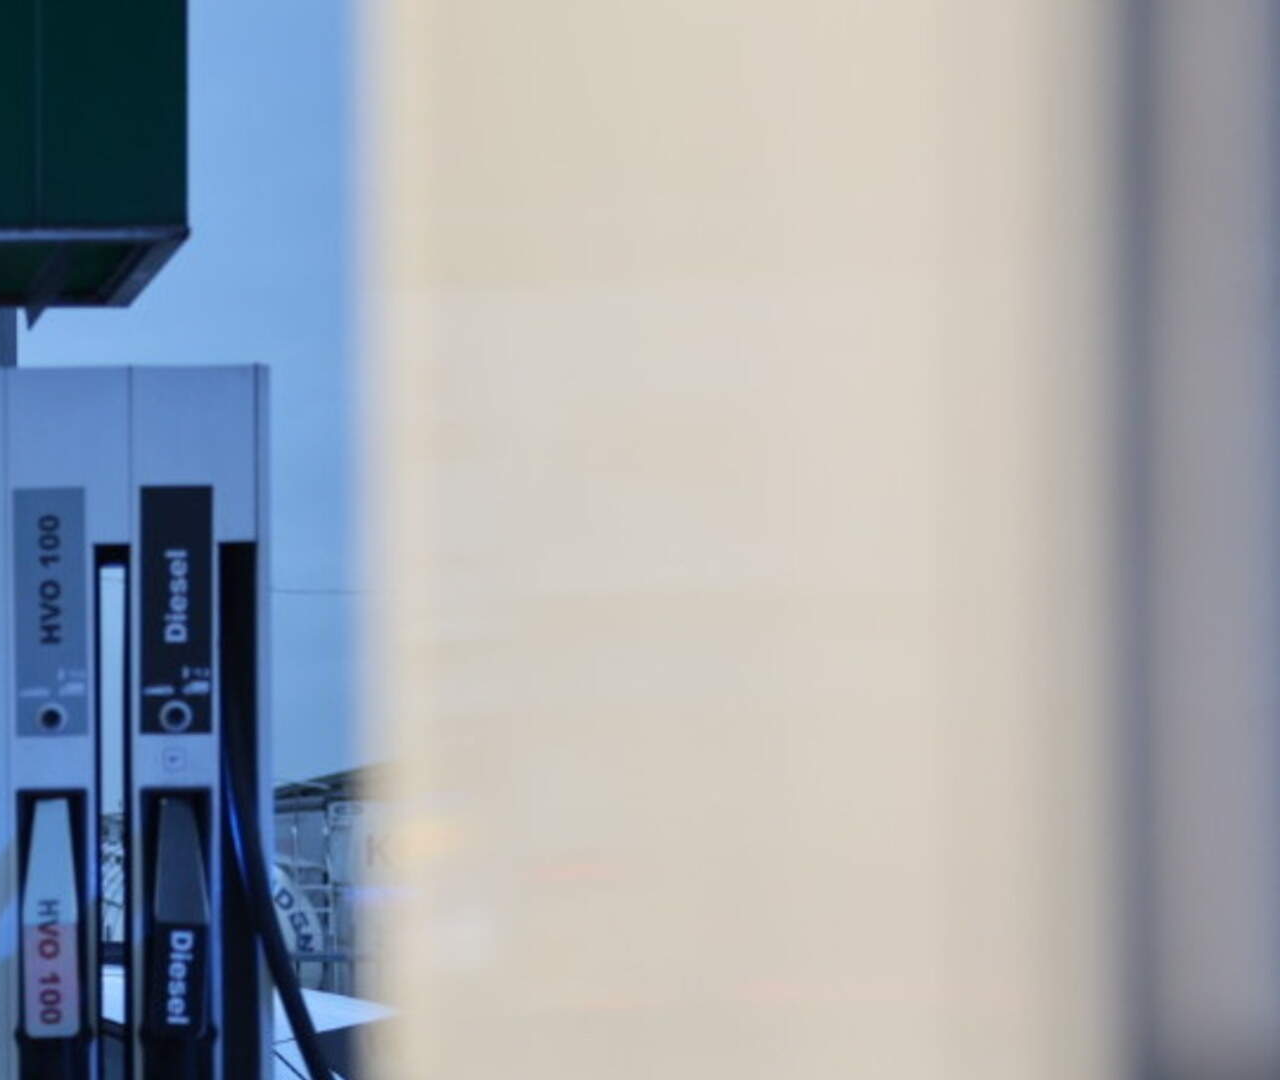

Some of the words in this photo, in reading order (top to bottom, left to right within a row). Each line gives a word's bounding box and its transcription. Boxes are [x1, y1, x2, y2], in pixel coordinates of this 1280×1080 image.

[38, 514, 61, 568] 100
[39, 579, 62, 645] HVO
[164, 549, 188, 643] Diesel
[37, 899, 61, 960] HVO
[40, 972, 63, 1026] 100
[166, 930, 195, 1026] Diesel
